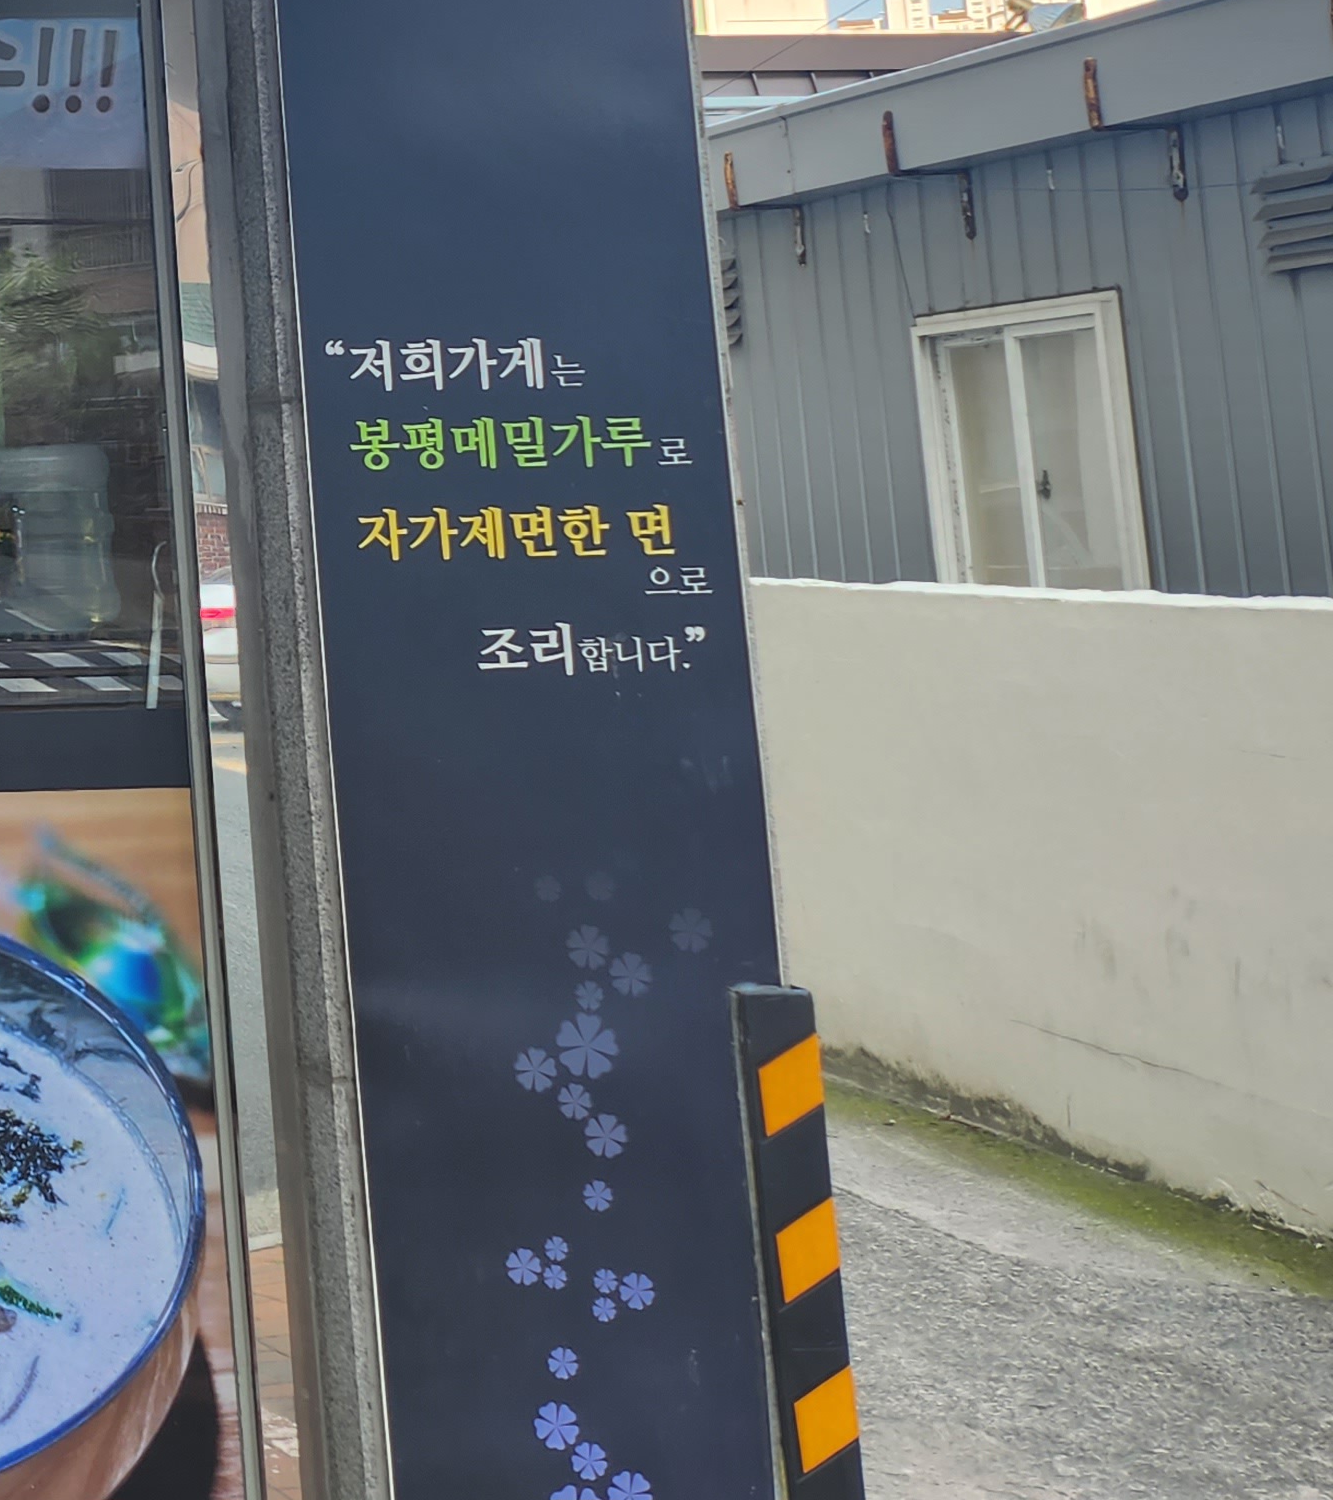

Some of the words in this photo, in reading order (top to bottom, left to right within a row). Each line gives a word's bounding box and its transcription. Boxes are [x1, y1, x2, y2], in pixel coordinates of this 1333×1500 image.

[349, 415, 693, 470] 봉평메밀가루로
[357, 504, 611, 561] 자가제면한
[625, 503, 676, 557] 면
[644, 566, 714, 596] 으로
